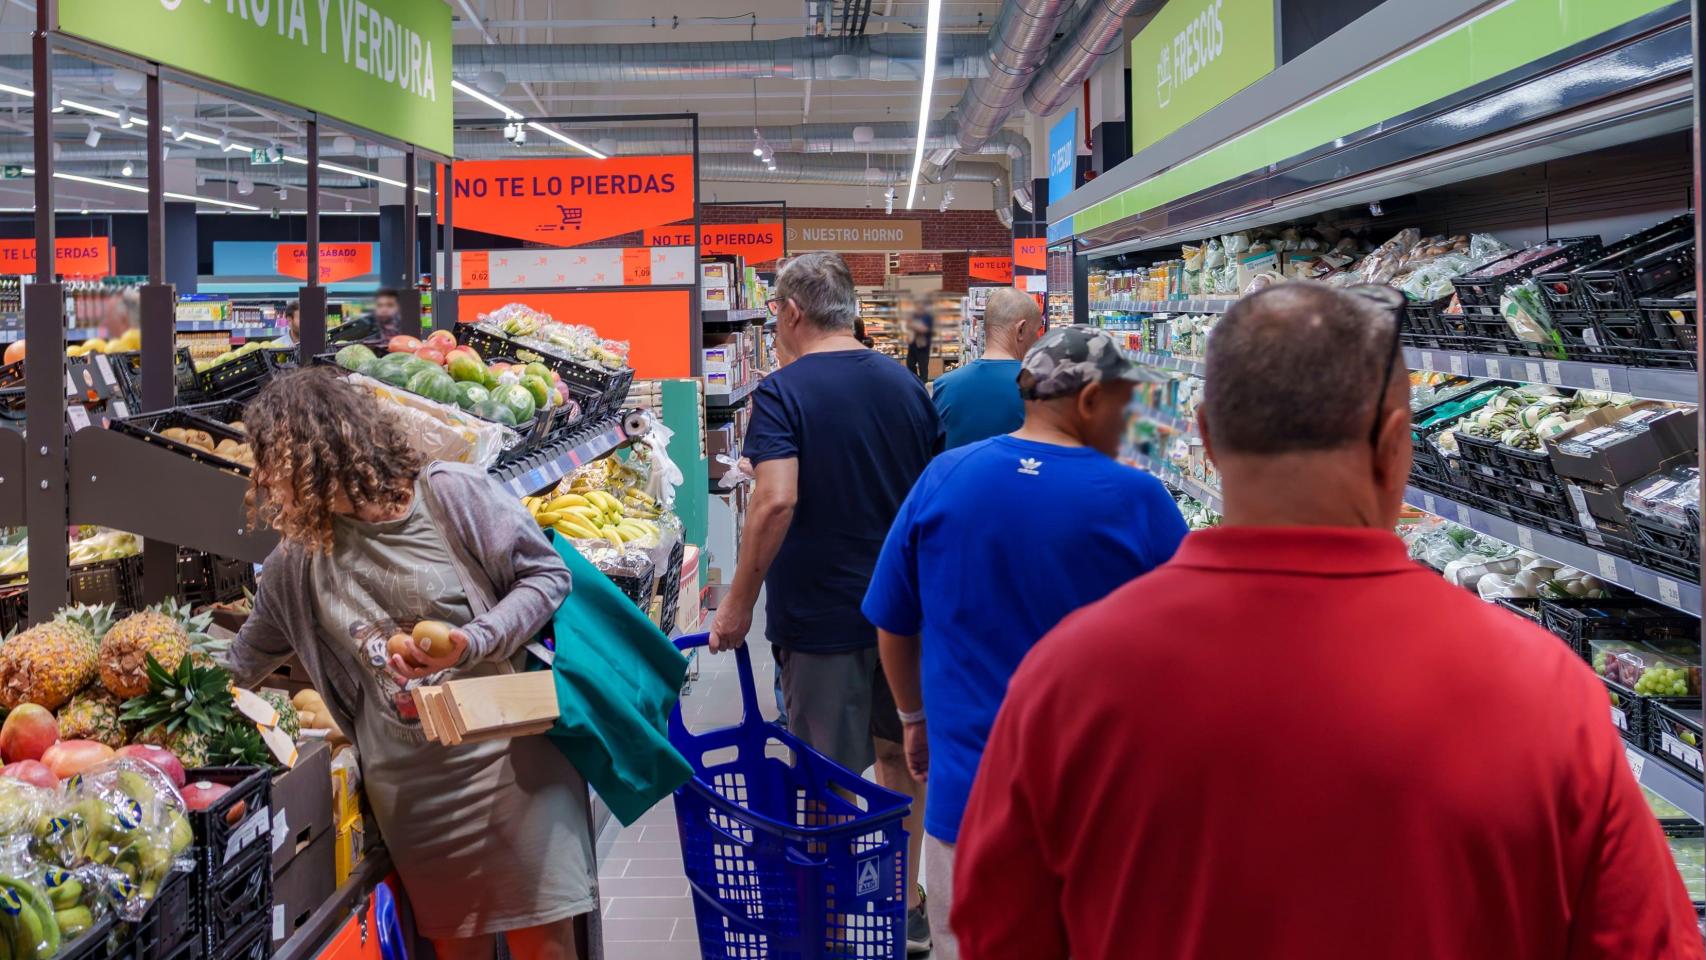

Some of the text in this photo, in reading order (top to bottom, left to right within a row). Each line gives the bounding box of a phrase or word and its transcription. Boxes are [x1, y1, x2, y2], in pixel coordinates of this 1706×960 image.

[1173, 0, 1224, 88] FRESCOS
[339, 0, 436, 102] VERDURA
[454, 173, 675, 198] NO TE LO PIERDAS
[652, 235, 671, 245] NO
[675, 234, 691, 245] TE
[716, 233, 773, 245] PIERDAS
[803, 228, 903, 241] NUESTRO HORNO
[3, 248, 18, 260] TE
[56, 247, 98, 259] ERDAS
[1021, 245, 1035, 254] NO
